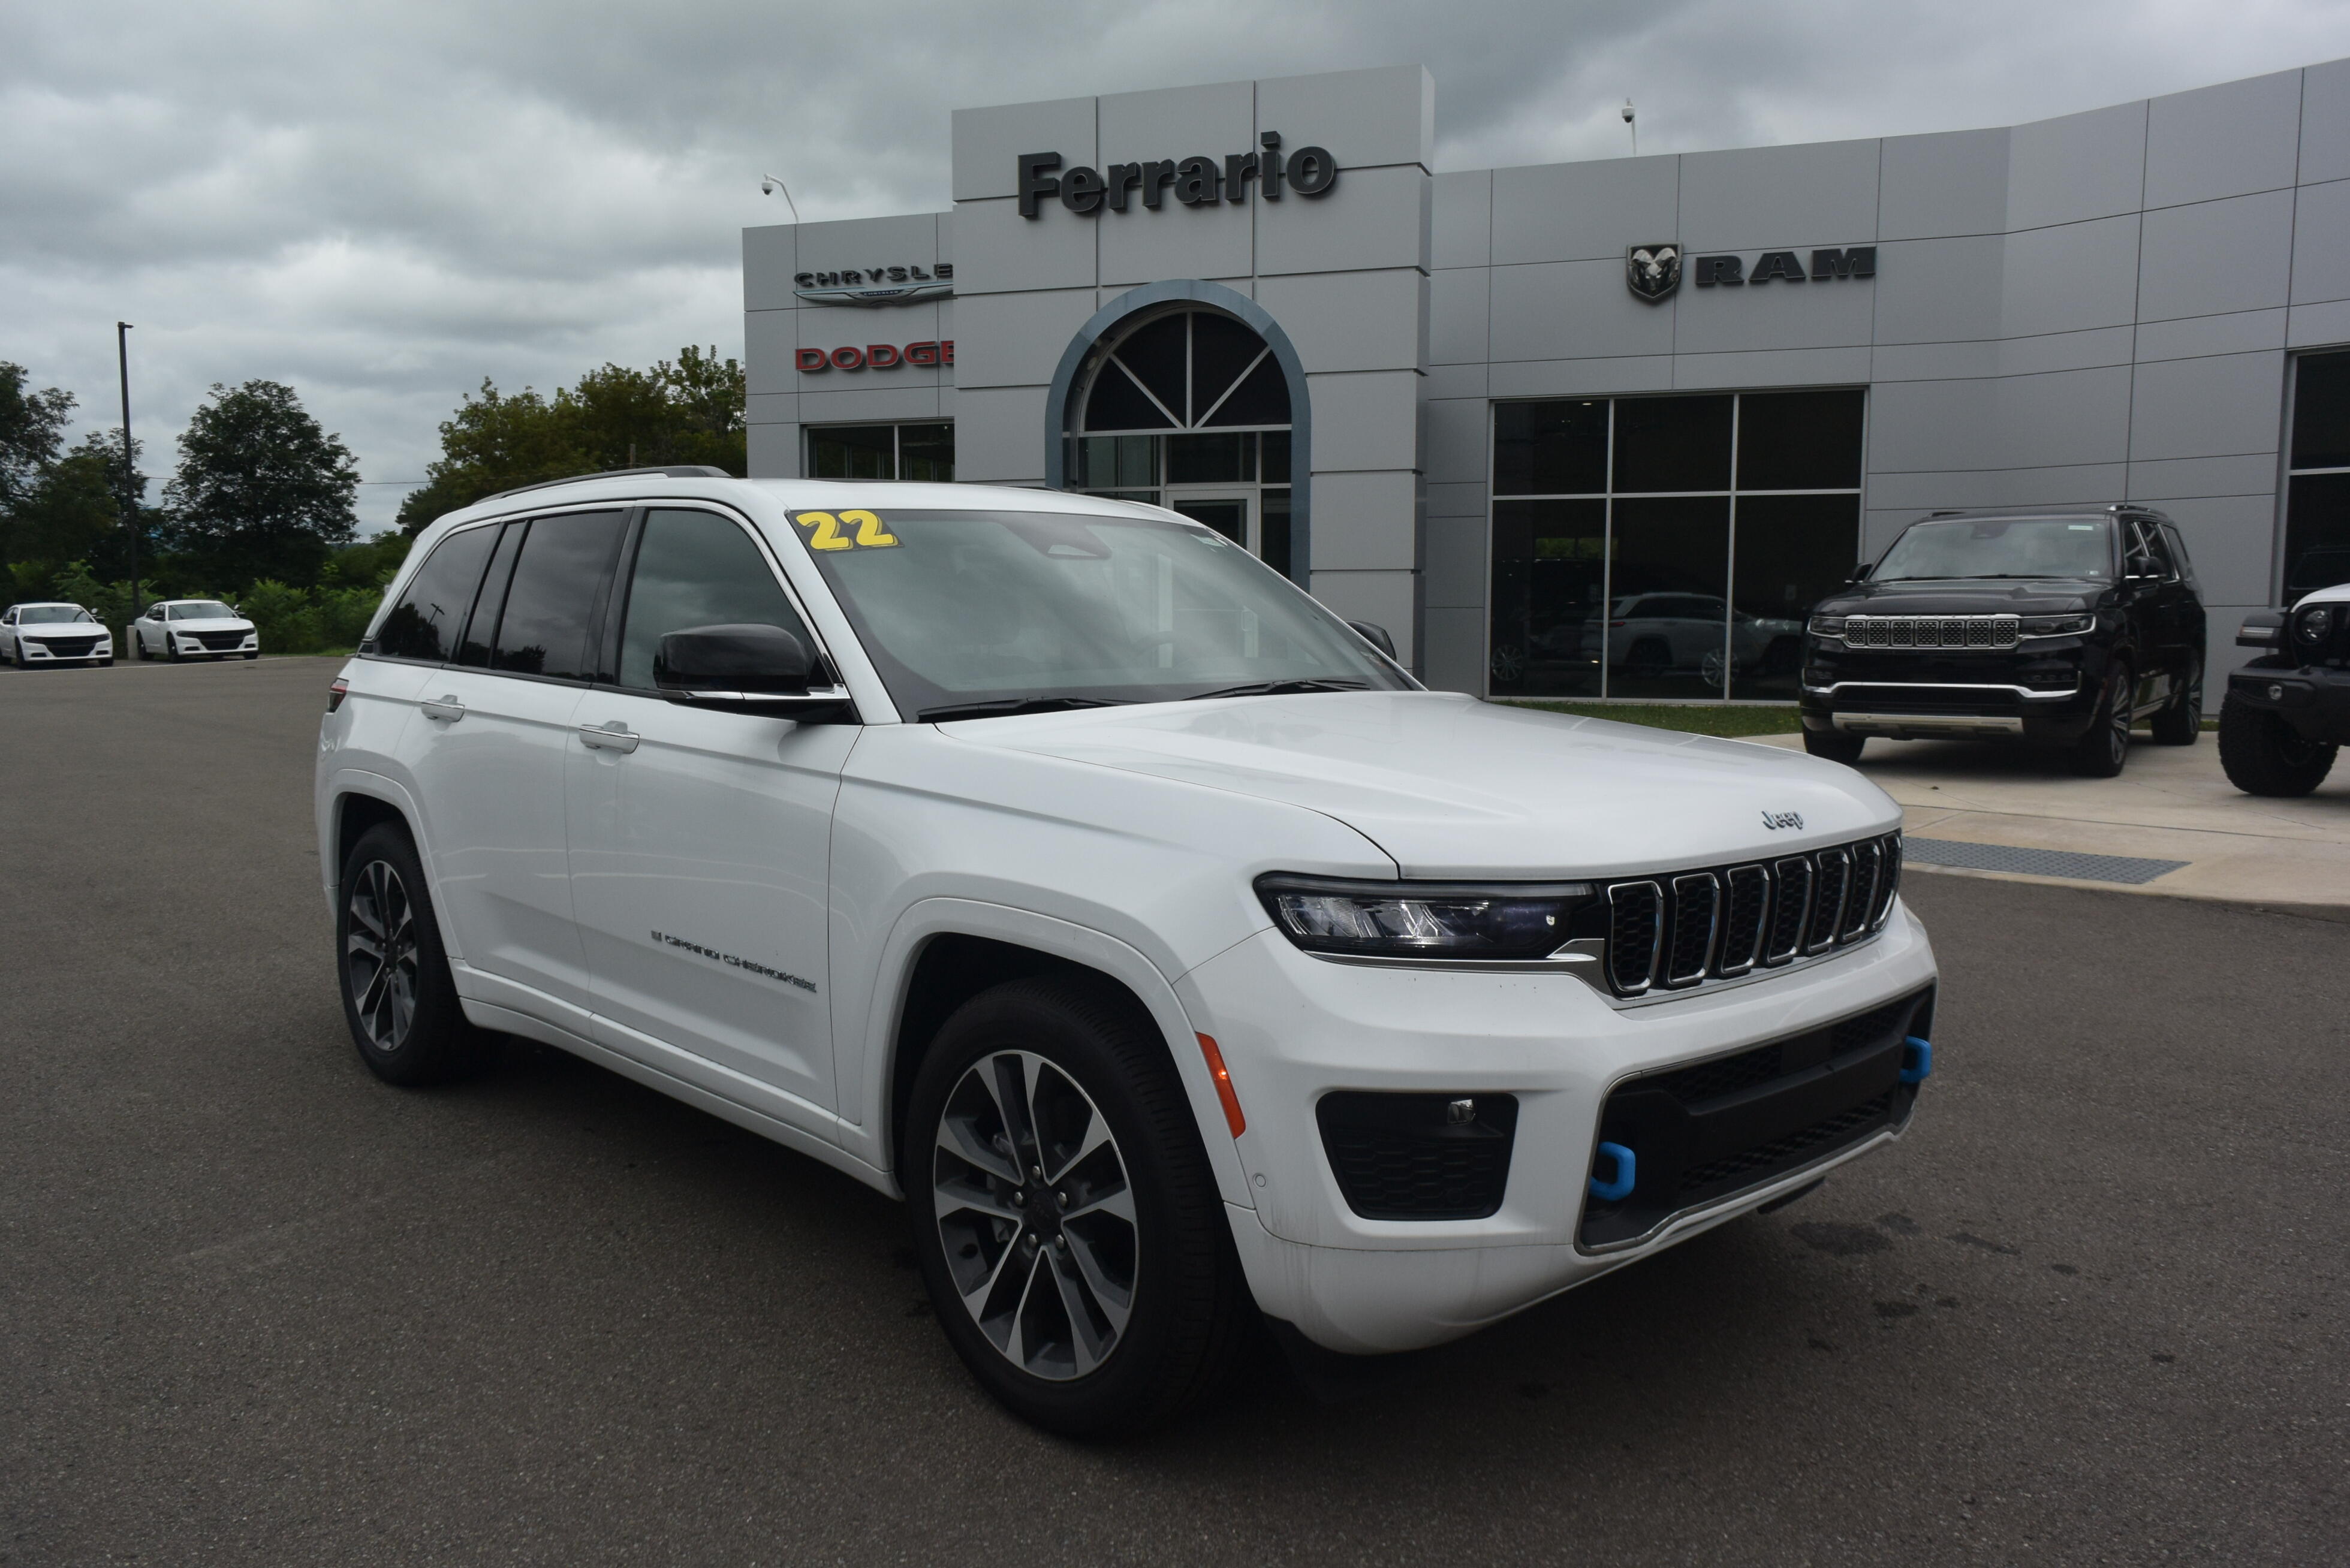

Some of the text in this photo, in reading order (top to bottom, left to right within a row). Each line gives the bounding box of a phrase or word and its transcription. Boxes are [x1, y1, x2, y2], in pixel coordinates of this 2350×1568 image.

[1017, 131, 1337, 218] Ferrario
[1695, 246, 1876, 287] RAM
[796, 340, 954, 372] DODGE
[796, 509, 899, 551] 22
[1761, 810, 1803, 830] Jeep
[665, 934, 817, 993] GRAND CHEROKEE
